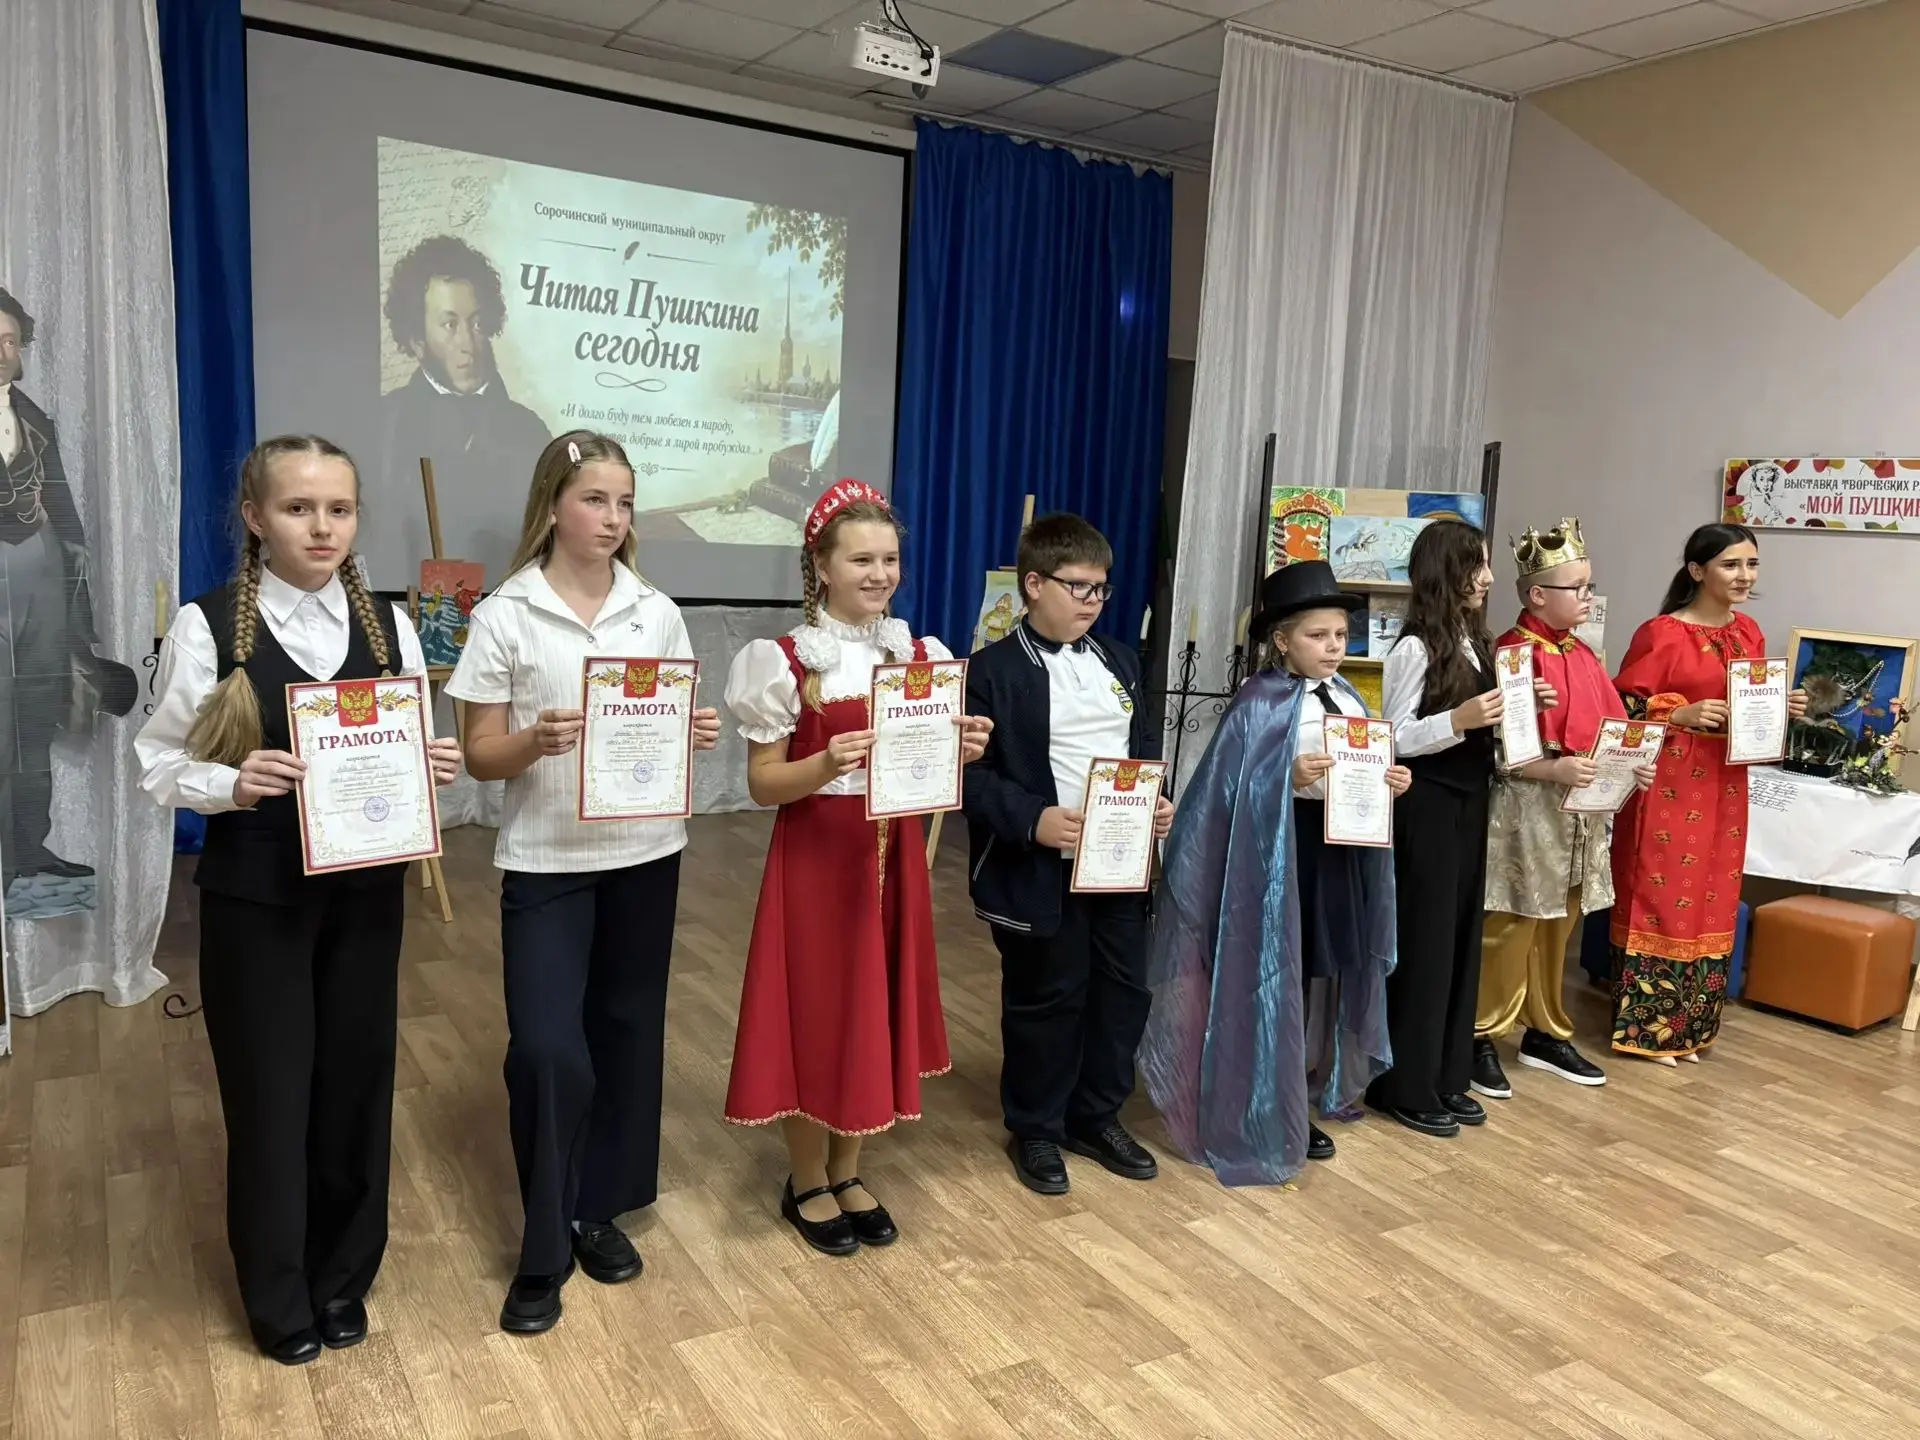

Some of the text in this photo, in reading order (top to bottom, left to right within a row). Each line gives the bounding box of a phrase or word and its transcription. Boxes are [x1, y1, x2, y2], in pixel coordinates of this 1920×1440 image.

[534, 202, 726, 246] Сорочинский муниципальный округ
[520, 263, 760, 333] Читая Пушкина
[574, 328, 701, 372] сегодня
[578, 404, 605, 420] долго
[607, 407, 629, 426] буду
[631, 413, 652, 424] тем
[654, 413, 692, 428] любезен
[693, 420, 699, 429] я
[701, 418, 734, 436] народу,
[629, 431, 663, 449] добрые
[664, 438, 671, 447] я
[673, 438, 700, 452] лирой
[1784, 478, 1920, 492] ВЫСТАВКА ТВОРЧЕСКИХ Р
[1799, 492, 1843, 514] «МОЙ
[1739, 687, 1780, 697] ГРАМОТА
[602, 703, 678, 716] ГРАМОТА
[887, 702, 950, 719] ГРАМОТА
[318, 729, 408, 750] ГРАМОТА
[1337, 751, 1384, 764] ГРАМОТА
[1603, 748, 1647, 758] ГРАМОТА
[1098, 795, 1148, 807] ГРАМОТА
